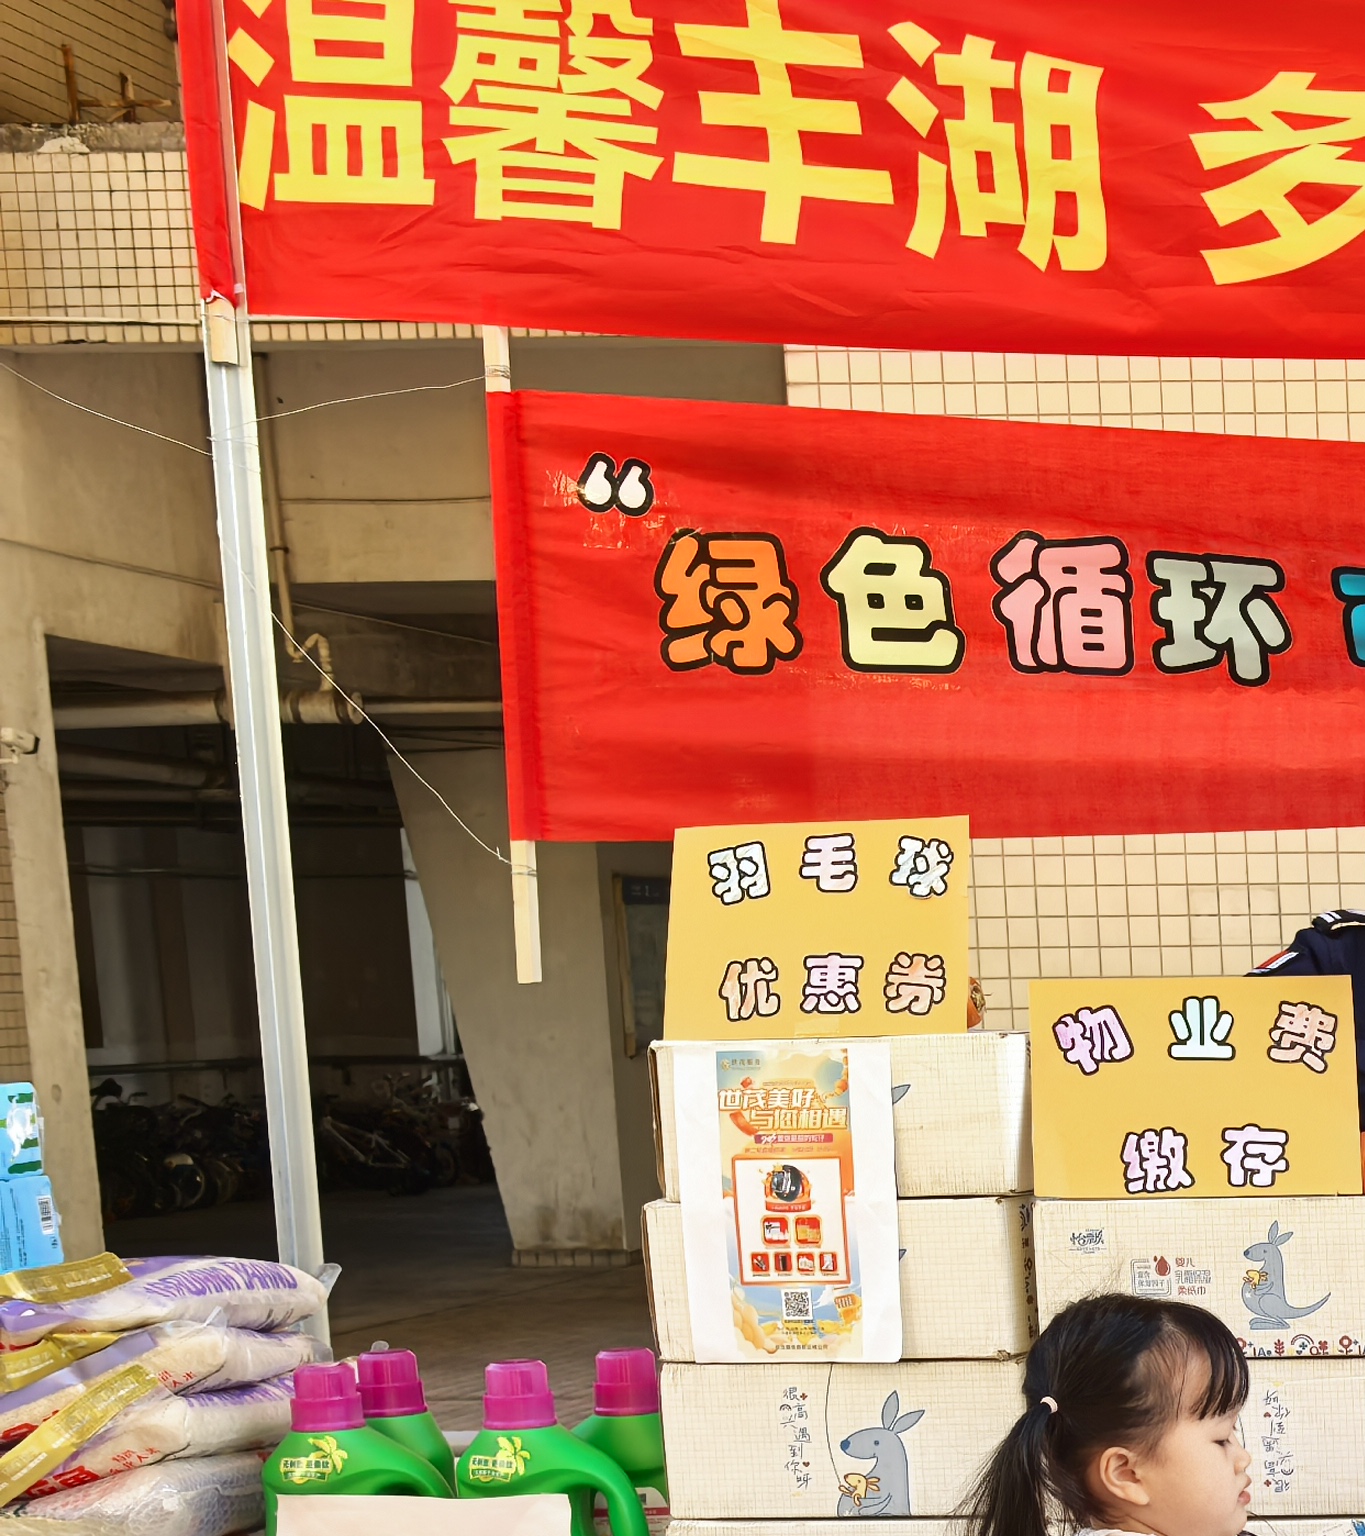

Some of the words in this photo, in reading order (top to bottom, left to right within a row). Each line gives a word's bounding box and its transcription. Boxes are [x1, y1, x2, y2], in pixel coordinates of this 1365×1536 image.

[228, 0, 1107, 272] 温馨丰湖
[707, 832, 954, 906] 羽毛球
[718, 951, 947, 1022] 优惠券
[1052, 996, 1340, 1074] 物业费
[718, 1088, 815, 1110] 世茂美好
[749, 1107, 849, 1131] 与您相遇
[1121, 1123, 1290, 1195] 缴存
